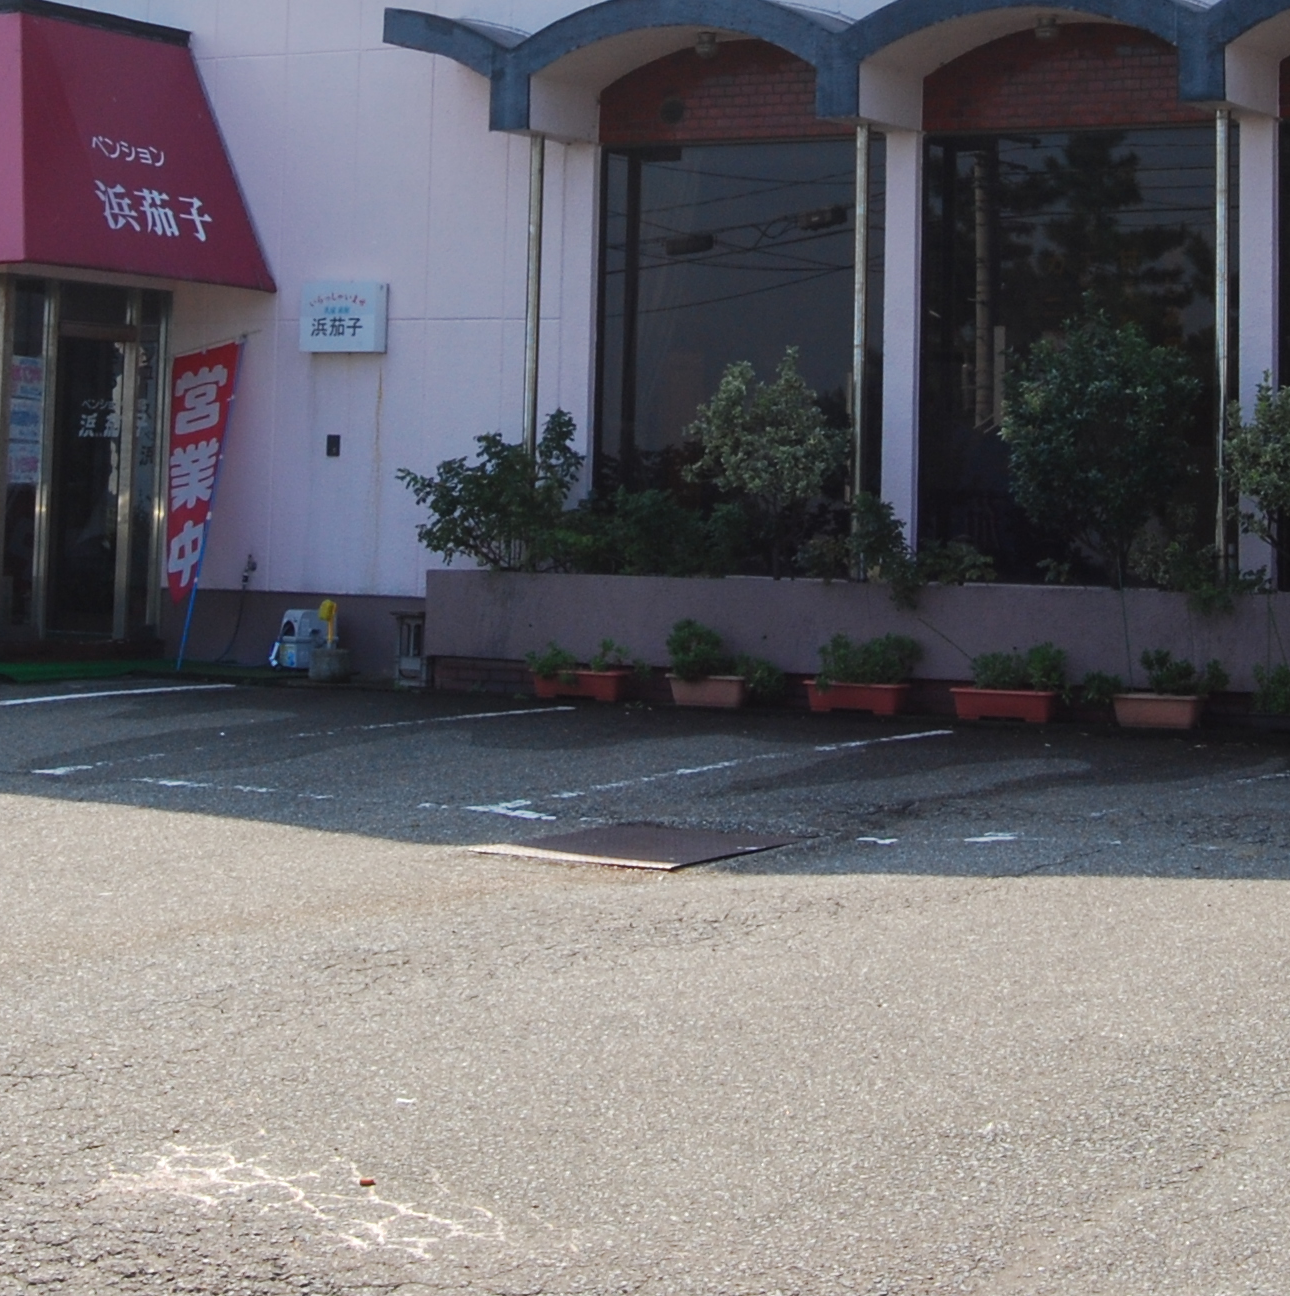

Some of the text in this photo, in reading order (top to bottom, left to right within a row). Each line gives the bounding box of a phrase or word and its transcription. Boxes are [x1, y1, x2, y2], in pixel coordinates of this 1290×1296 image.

[91, 135, 165, 167] ペンション
[94, 179, 213, 242] 浜茄子
[310, 316, 363, 337] 浜茄子
[168, 364, 228, 588] 営業中
